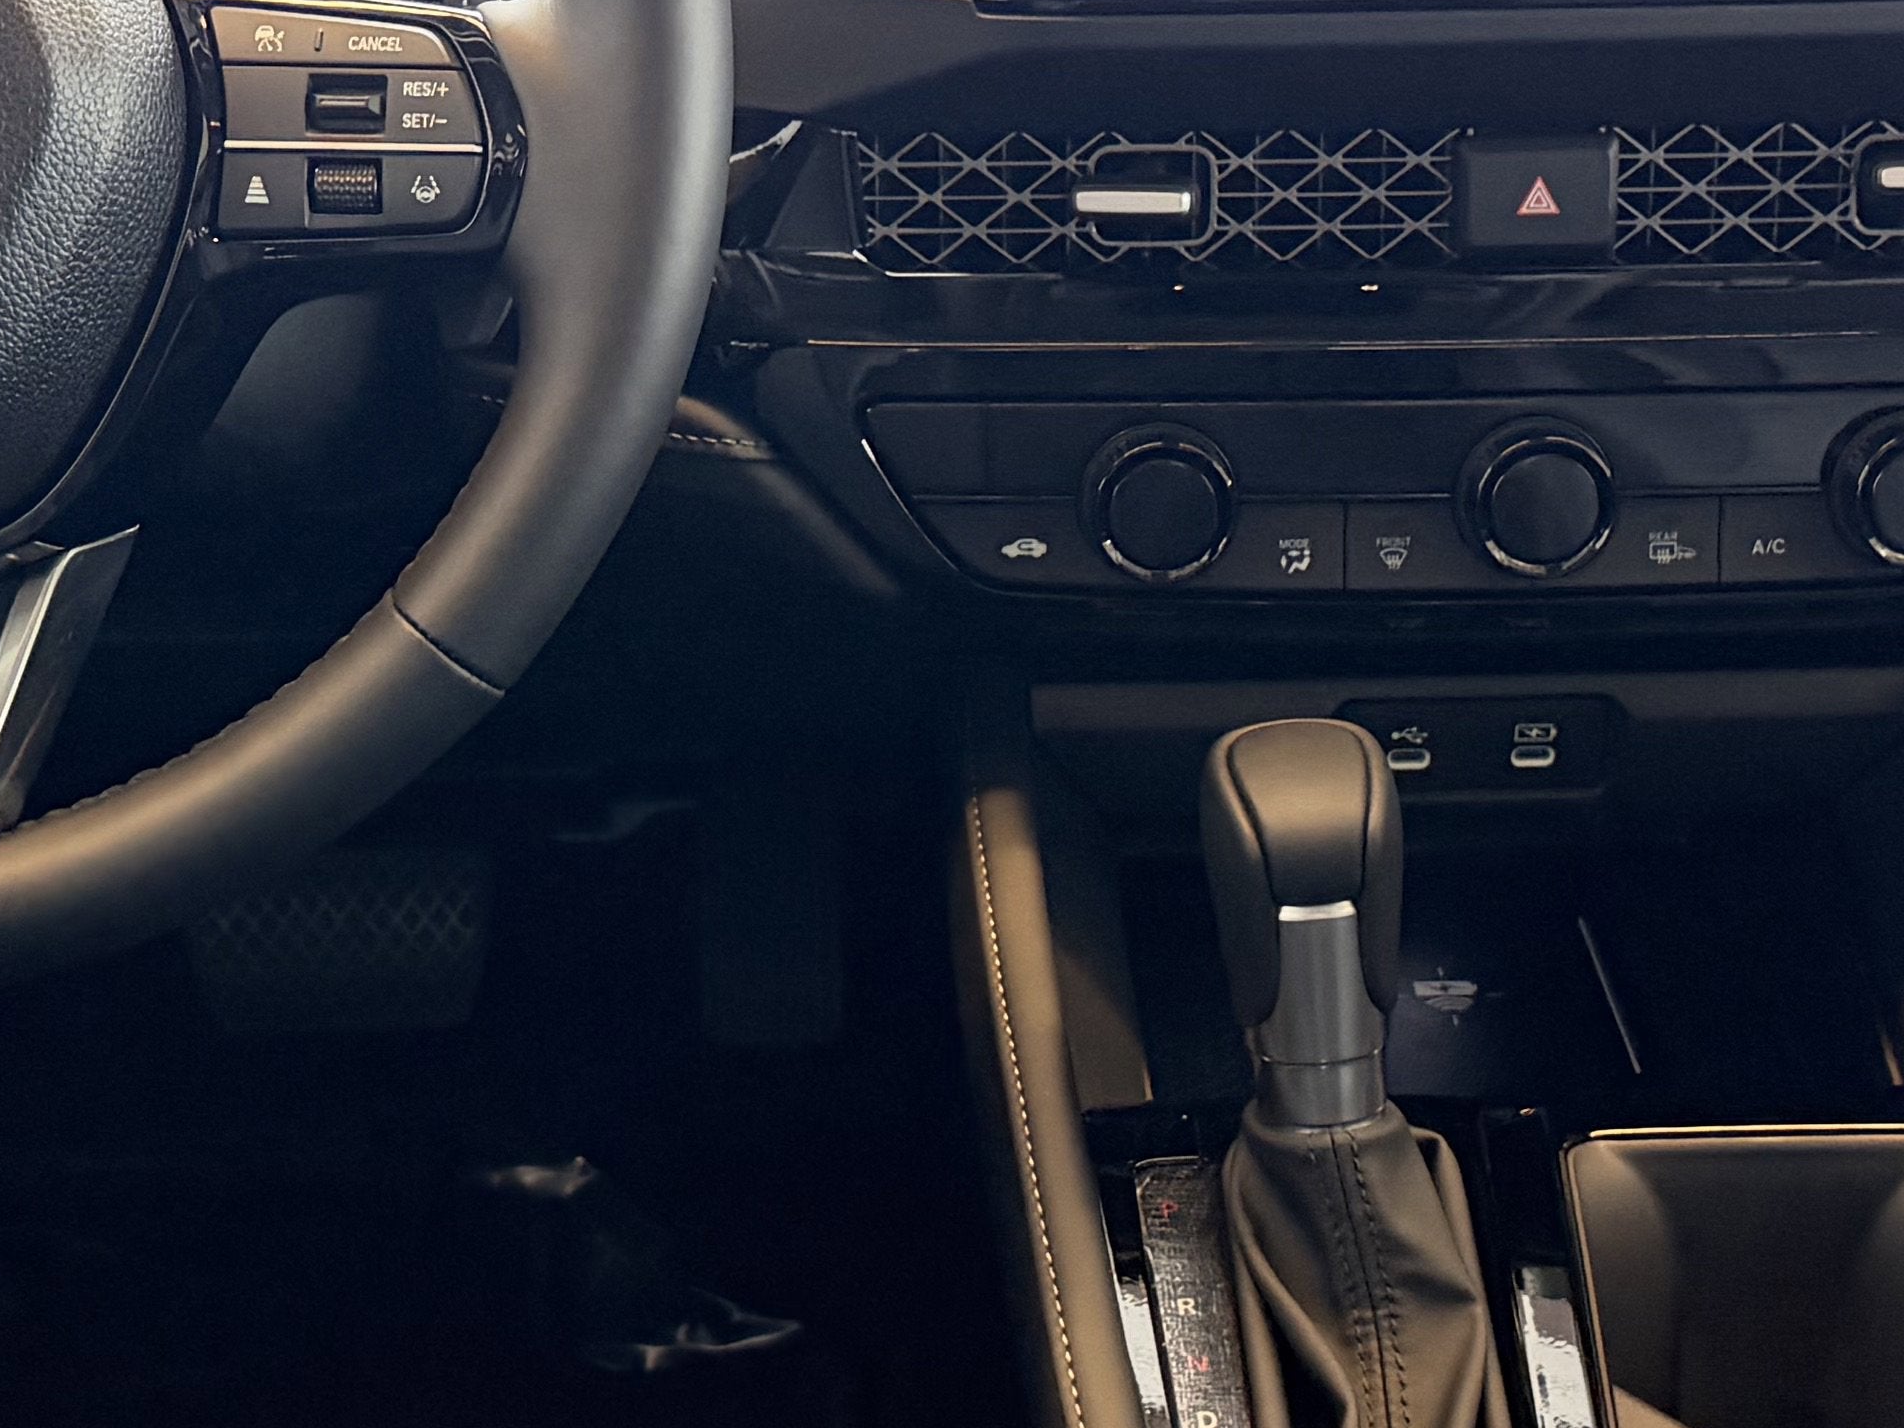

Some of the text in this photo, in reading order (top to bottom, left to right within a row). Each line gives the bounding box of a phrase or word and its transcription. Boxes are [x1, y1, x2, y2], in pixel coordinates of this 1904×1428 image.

[348, 36, 403, 52] CANCEL
[402, 81, 449, 97] RES/+
[1279, 538, 1310, 549] MODE
[1752, 538, 1786, 555] A/C
[1177, 1297, 1196, 1316] R
